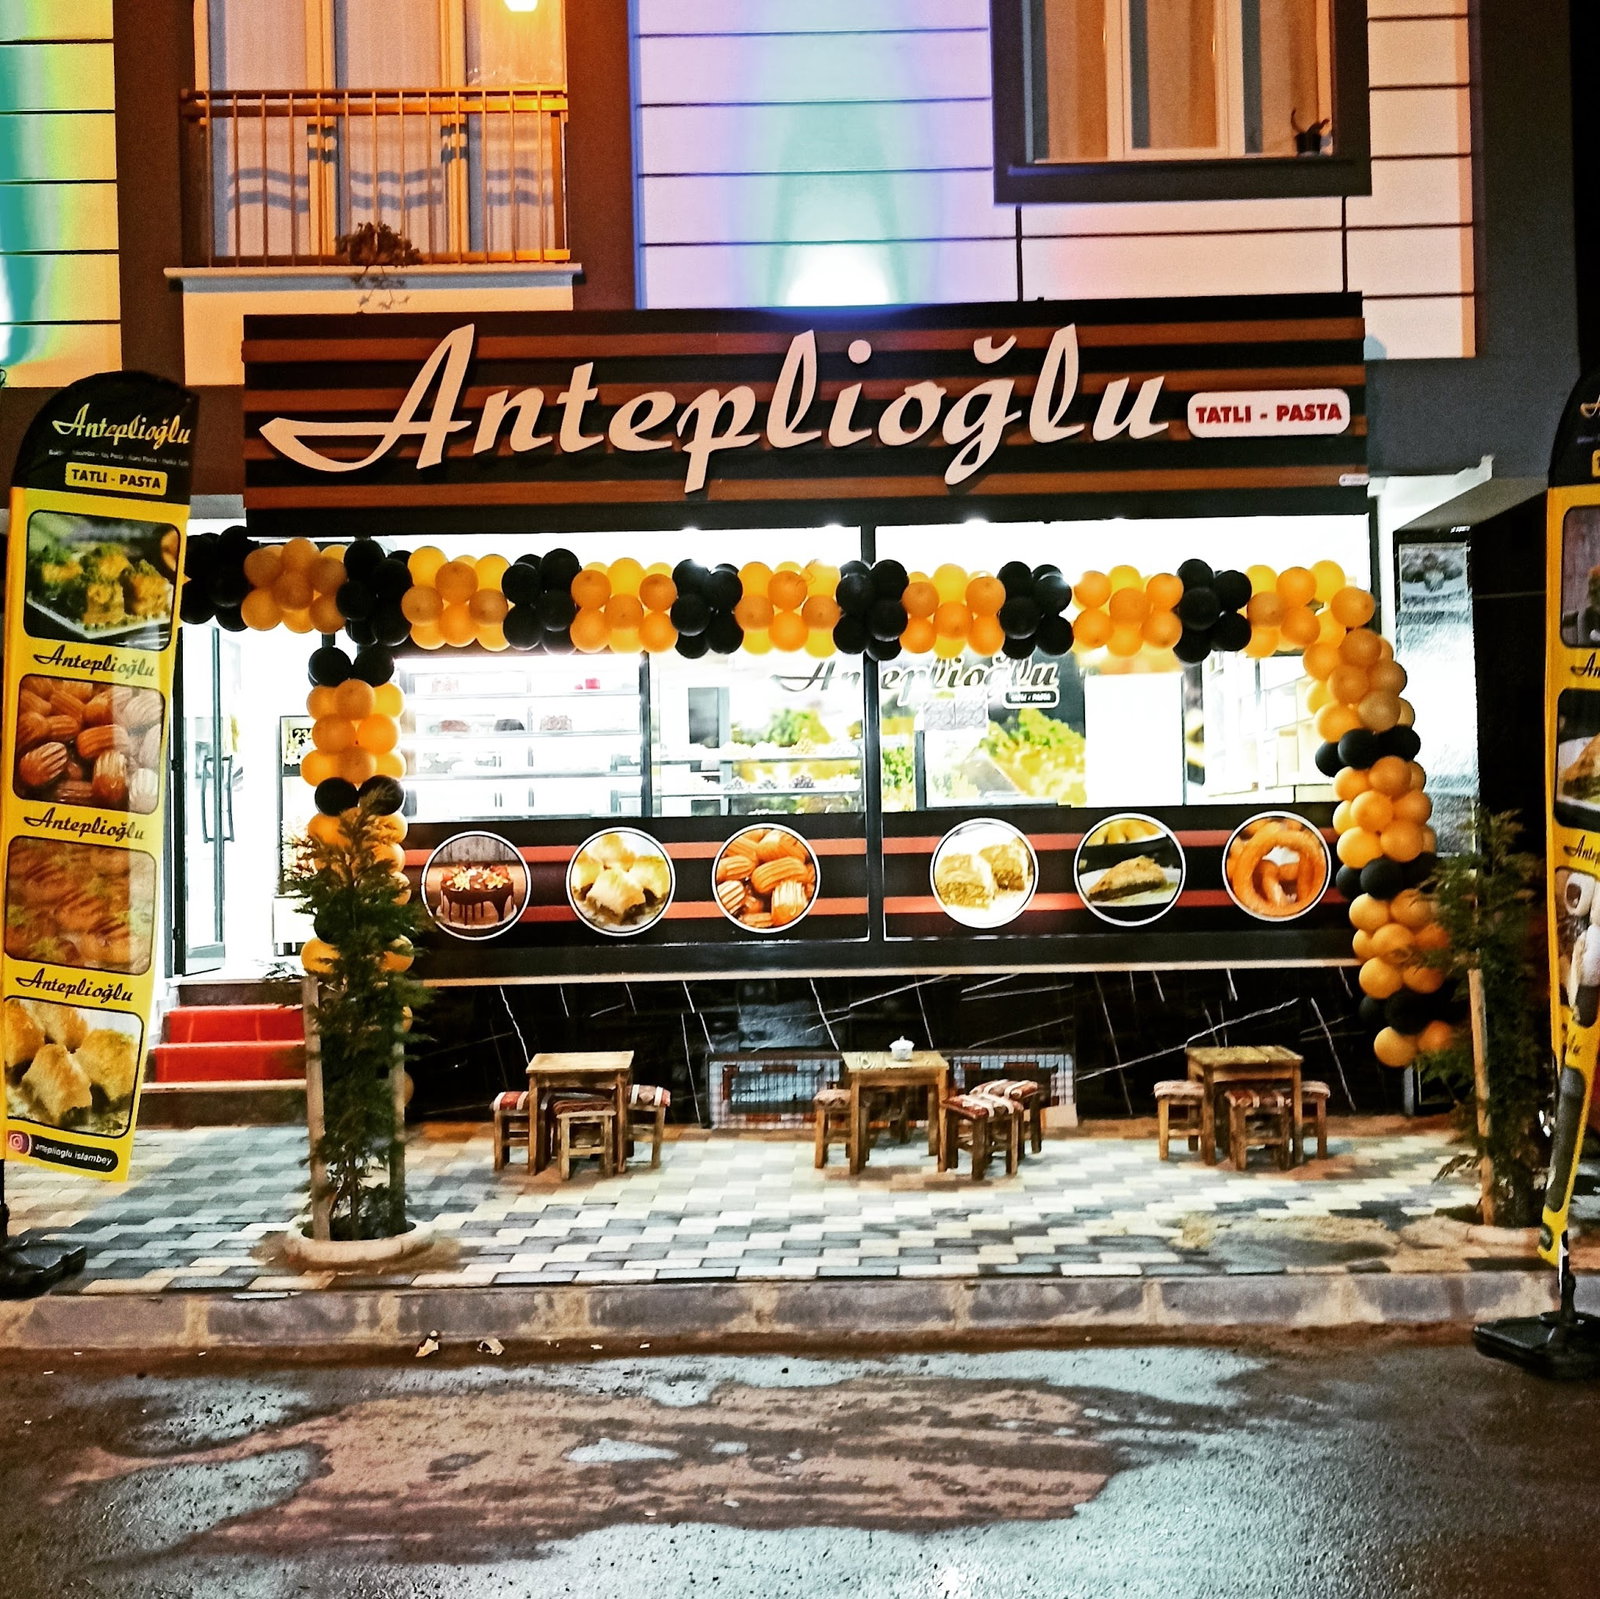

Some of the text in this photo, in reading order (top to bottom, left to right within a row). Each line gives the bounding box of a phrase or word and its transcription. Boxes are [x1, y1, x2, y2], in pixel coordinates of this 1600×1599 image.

[259, 323, 1170, 493] Anteplioğlu
[1195, 406, 1252, 423] TATLI
[1276, 403, 1342, 422] PASTA
[52, 403, 191, 450] Anteplioğlu
[71, 468, 108, 484] TATLI
[119, 473, 161, 489] PASTA
[33, 644, 156, 680] Anteplioğlu
[24, 806, 145, 842] Anteplioğlu
[15, 967, 134, 1004] Anteplioğlu
